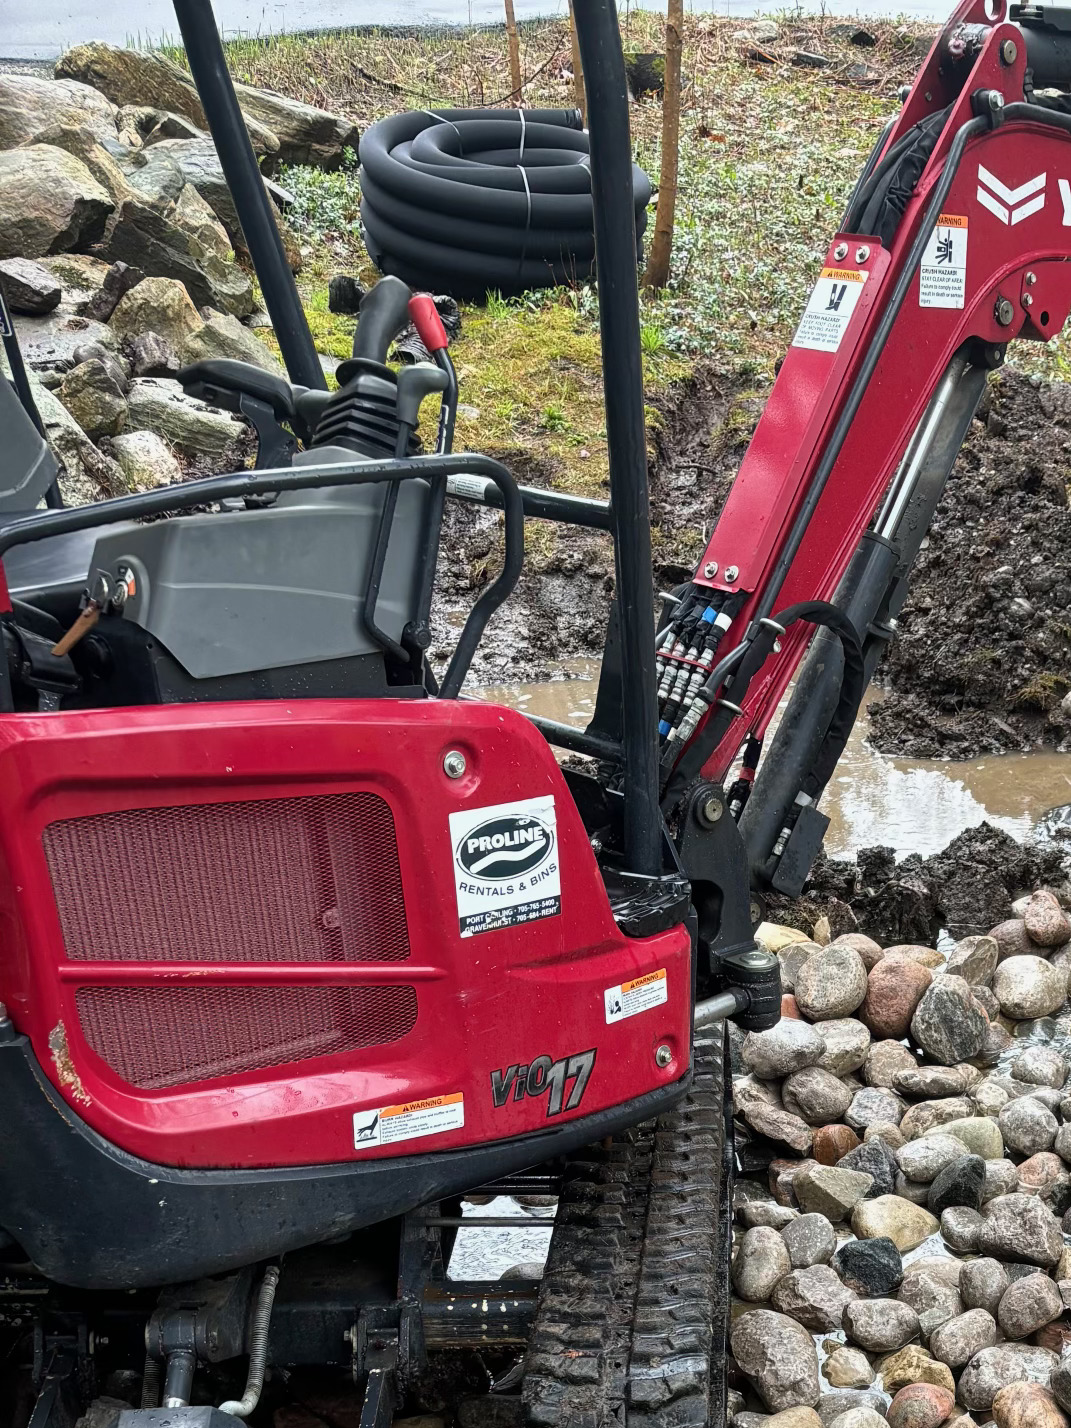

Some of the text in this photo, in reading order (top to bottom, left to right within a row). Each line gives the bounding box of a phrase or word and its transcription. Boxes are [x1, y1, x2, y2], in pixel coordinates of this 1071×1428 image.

[833, 271, 861, 281] WARNING
[467, 826, 545, 854] PROLINE
[459, 862, 557, 896] RENTALS & BINS
[466, 915, 484, 925] PORT
[635, 972, 659, 987] WARNING
[409, 1098, 443, 1111] WARNING
